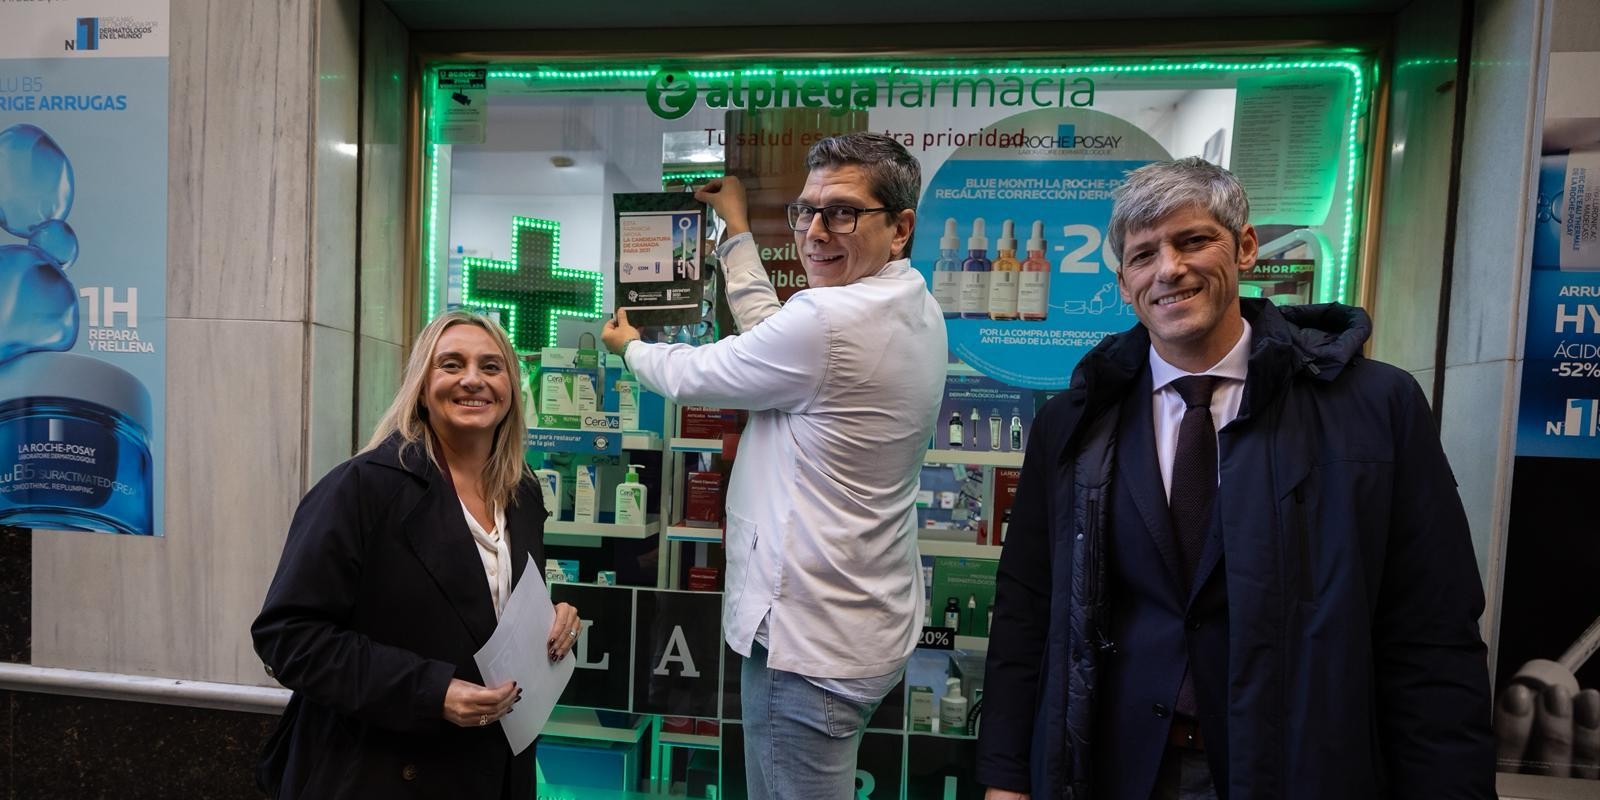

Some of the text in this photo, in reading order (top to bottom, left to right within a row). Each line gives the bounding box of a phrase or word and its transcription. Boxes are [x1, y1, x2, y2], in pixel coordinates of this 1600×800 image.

[22, 77, 43, 92] B5
[705, 64, 1096, 118] alphega farmacia
[39, 95, 127, 111] ARRUGAS
[704, 128, 725, 146] Tu
[736, 128, 793, 146] salud
[923, 127, 1025, 151] prioridad
[966, 178, 997, 189] BLUE
[999, 178, 1043, 189] MONTH
[1045, 179, 1059, 189] LA
[935, 187, 996, 201] REGÁLATE
[997, 187, 1077, 201] CORRECCIÓN
[1566, 186, 1577, 237] ROCHE-POSAY
[1558, 285, 1600, 297] ARRU
[79, 286, 138, 328] 1H
[88, 329, 140, 341] REPARA
[979, 328, 998, 336] POR
[1011, 329, 1050, 338] COMPRA
[1050, 330, 1060, 338] DE
[88, 340, 155, 353] Y RELLENA
[981, 336, 1027, 345] ANTI-EDAD
[1028, 337, 1039, 346] DE
[1040, 338, 1051, 346] LA
[1552, 362, 1600, 378] -52%
[584, 416, 619, 428] CeraVe
[18, 443, 96, 456] LA ROCHE-POSAY
[653, 625, 701, 678] A
